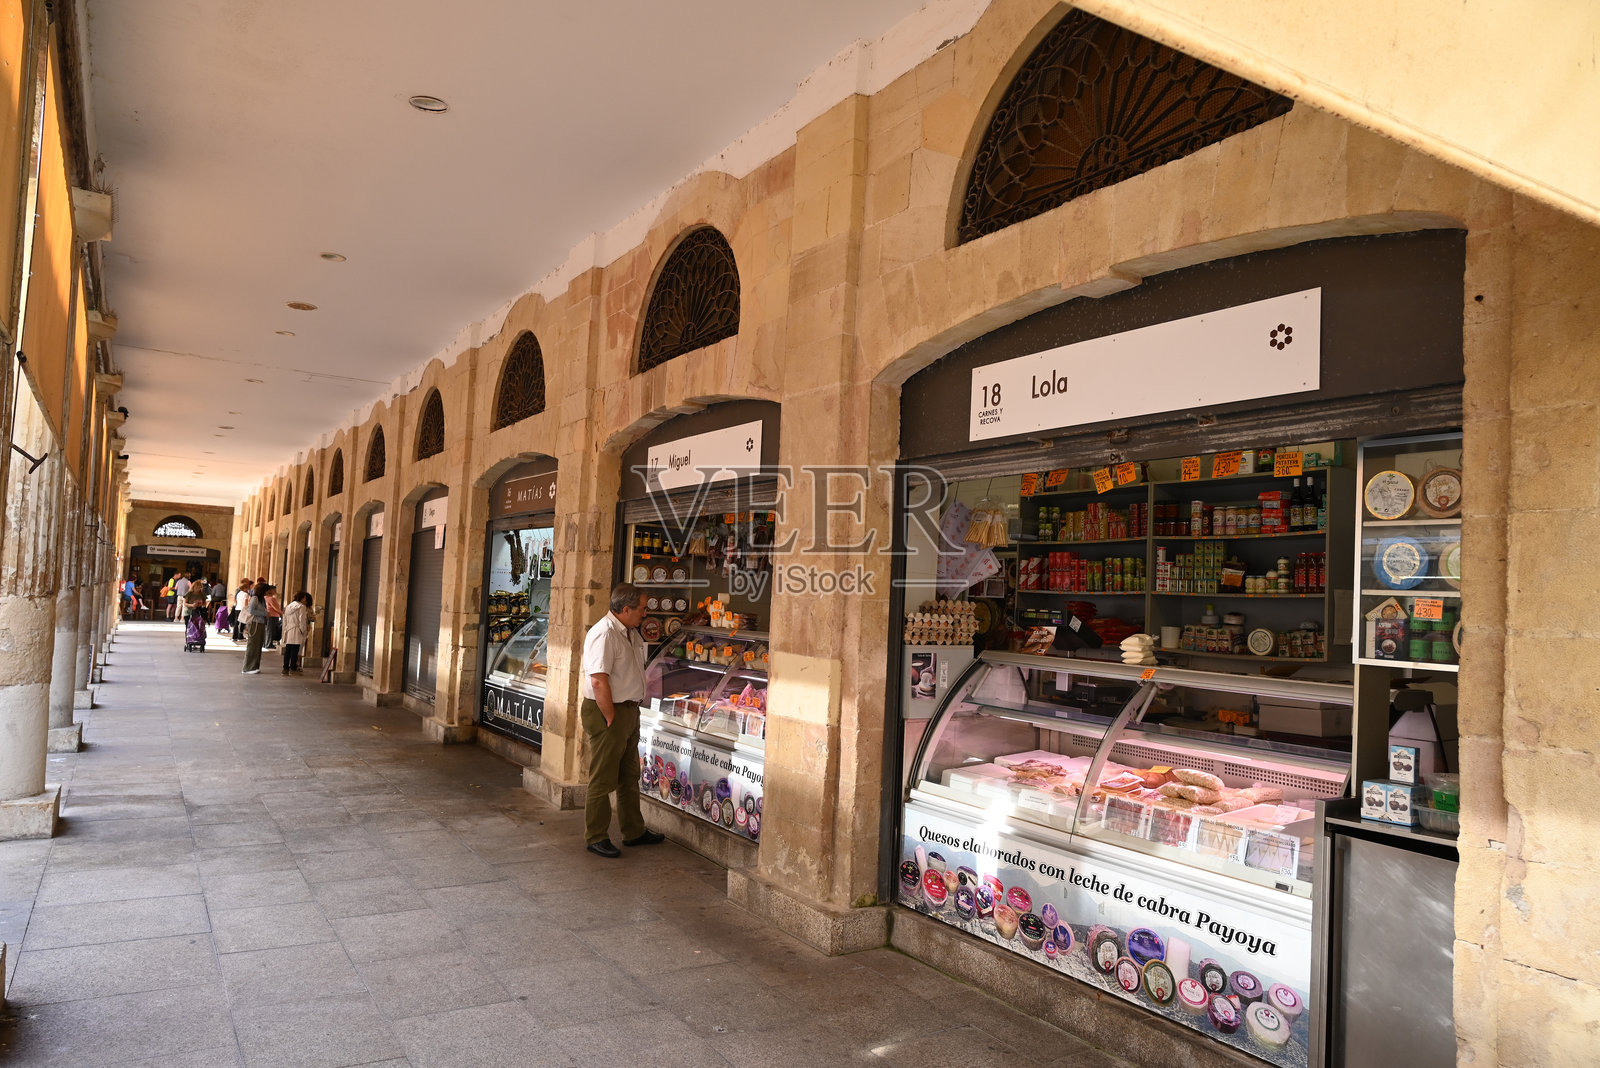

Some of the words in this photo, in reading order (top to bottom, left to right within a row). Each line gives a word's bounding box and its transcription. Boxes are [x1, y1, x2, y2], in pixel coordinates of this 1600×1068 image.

[982, 383, 1001, 408] 18
[1031, 369, 1068, 399] Lola
[978, 408, 998, 418] CARNES
[979, 416, 1001, 425] RECOVA
[650, 458, 659, 473] 17
[668, 449, 691, 472] Miguel
[517, 484, 543, 501] MATÍAS
[496, 696, 541, 730] MATÍAS
[651, 736, 680, 753] laborados
[680, 747, 692, 757] con
[692, 747, 710, 763] leche
[710, 754, 719, 766] de
[719, 759, 741, 775] cabra
[919, 825, 960, 848] Quesos
[962, 838, 1036, 871] elaborados
[1038, 863, 1066, 881] con
[1069, 868, 1110, 895] leche
[1113, 884, 1134, 903] de
[1137, 897, 1191, 924] cabra
[1195, 911, 1278, 956] Payoya
